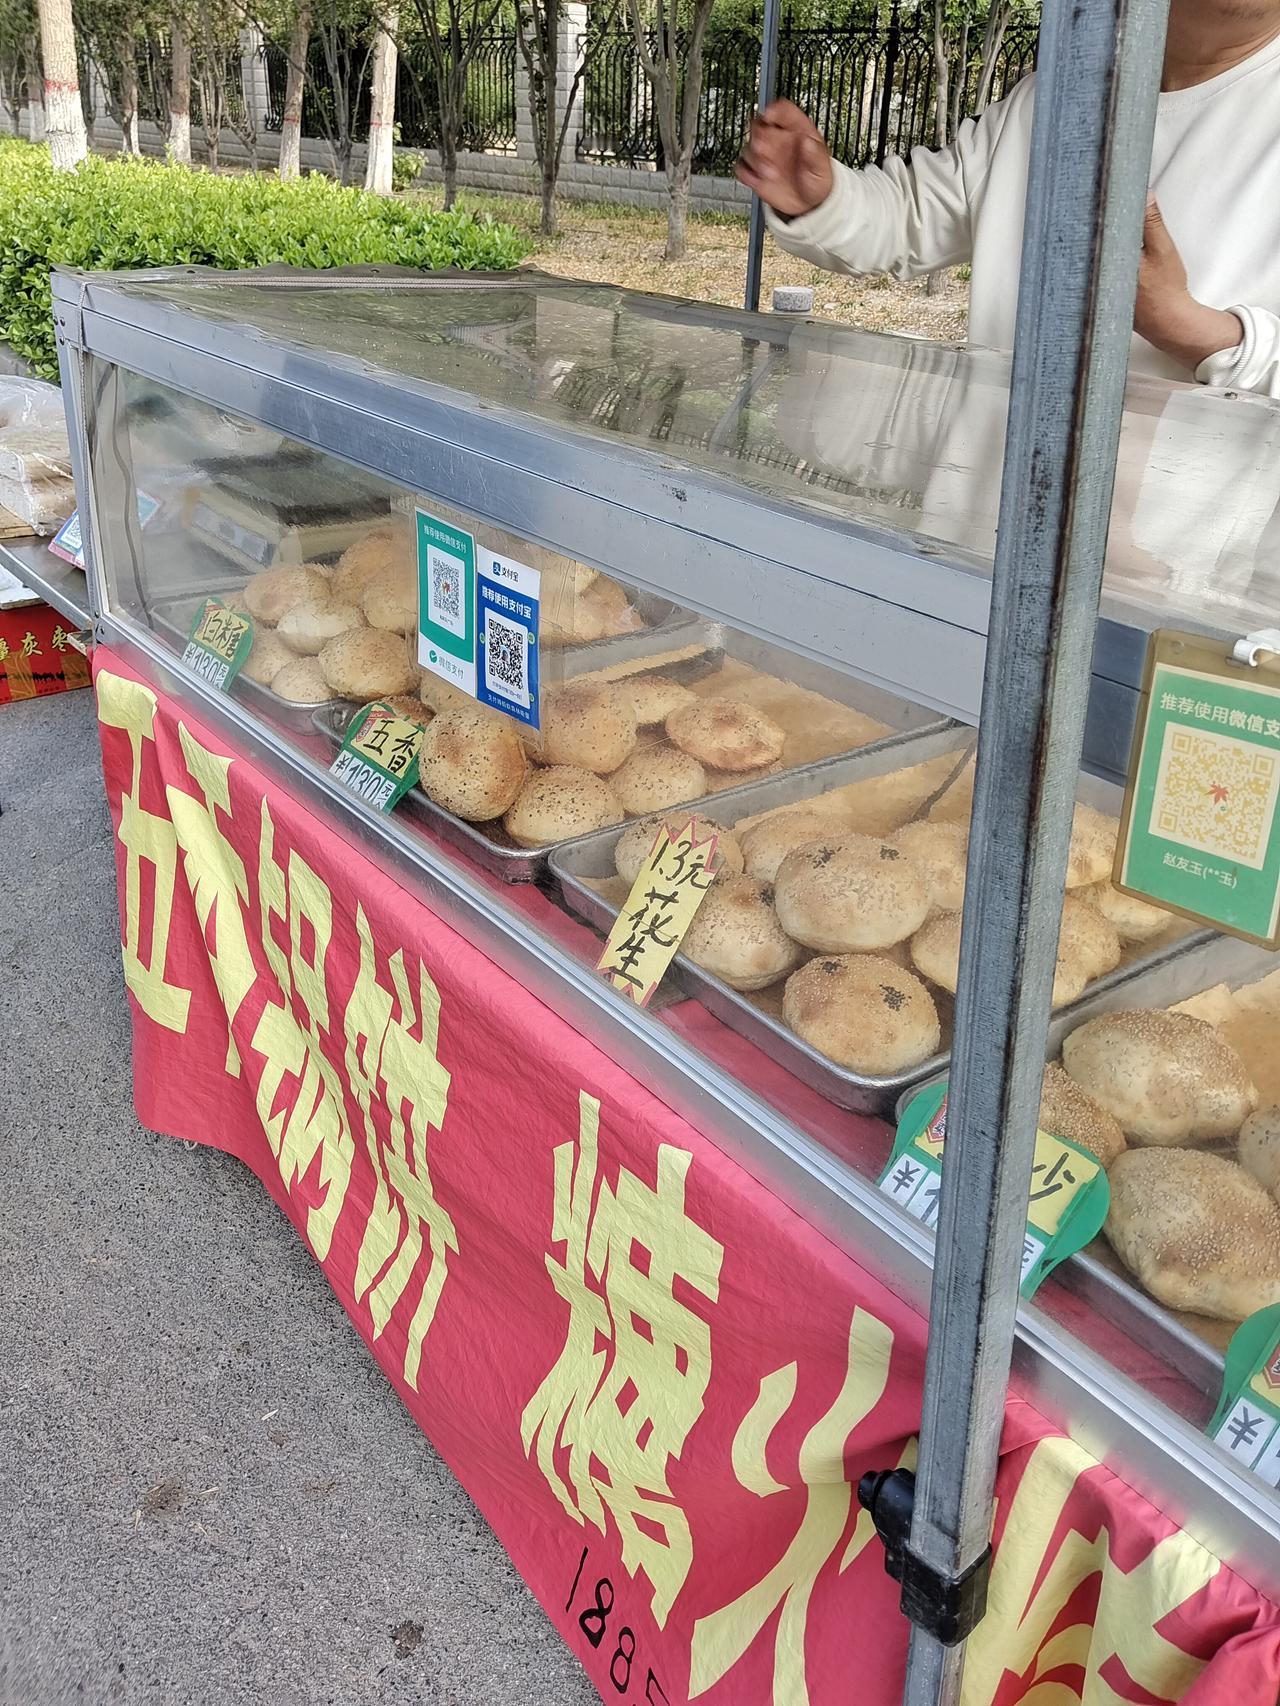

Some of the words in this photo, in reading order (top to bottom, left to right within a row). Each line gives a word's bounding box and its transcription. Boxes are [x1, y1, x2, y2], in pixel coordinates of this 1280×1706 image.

[423, 524, 468, 554] 推荐使用微信支付
[501, 566, 519, 583] 支付宝
[481, 585, 532, 620] 推荐使用支付宝
[362, 718, 419, 774] 五香
[610, 886, 680, 990] 花生
